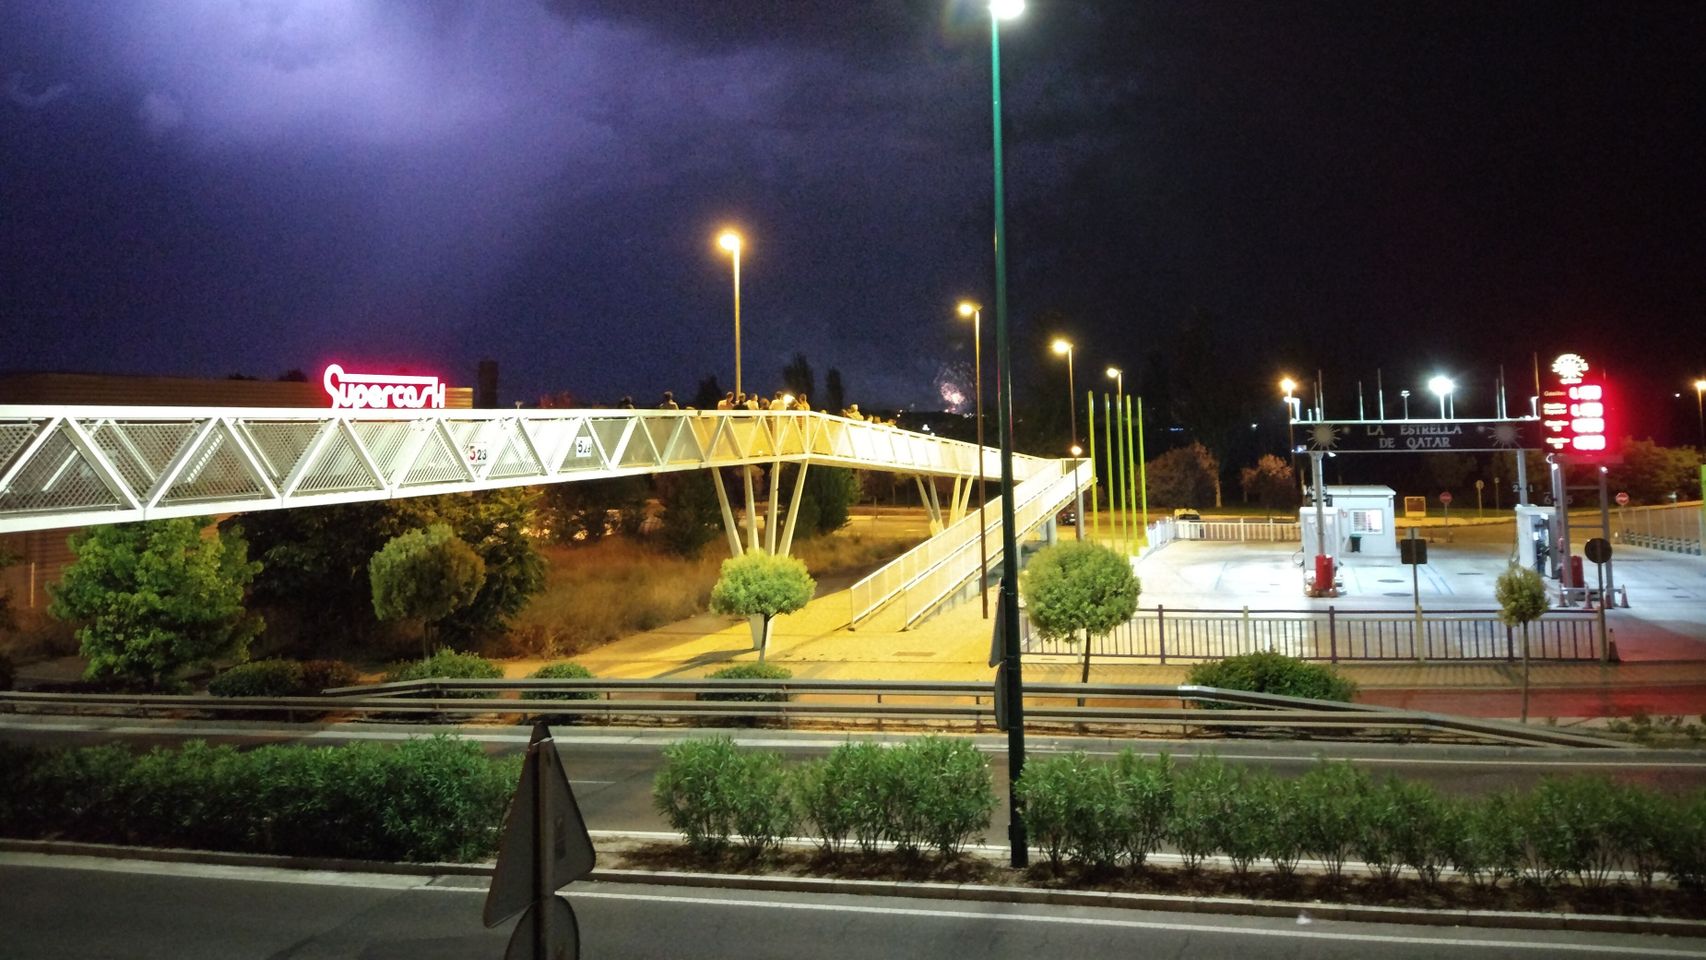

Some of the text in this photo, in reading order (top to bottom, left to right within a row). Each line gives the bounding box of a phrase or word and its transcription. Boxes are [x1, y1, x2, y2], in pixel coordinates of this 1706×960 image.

[1366, 423, 1462, 436] LA ESTRELLA
[1379, 437, 1451, 450] DE QATAR
